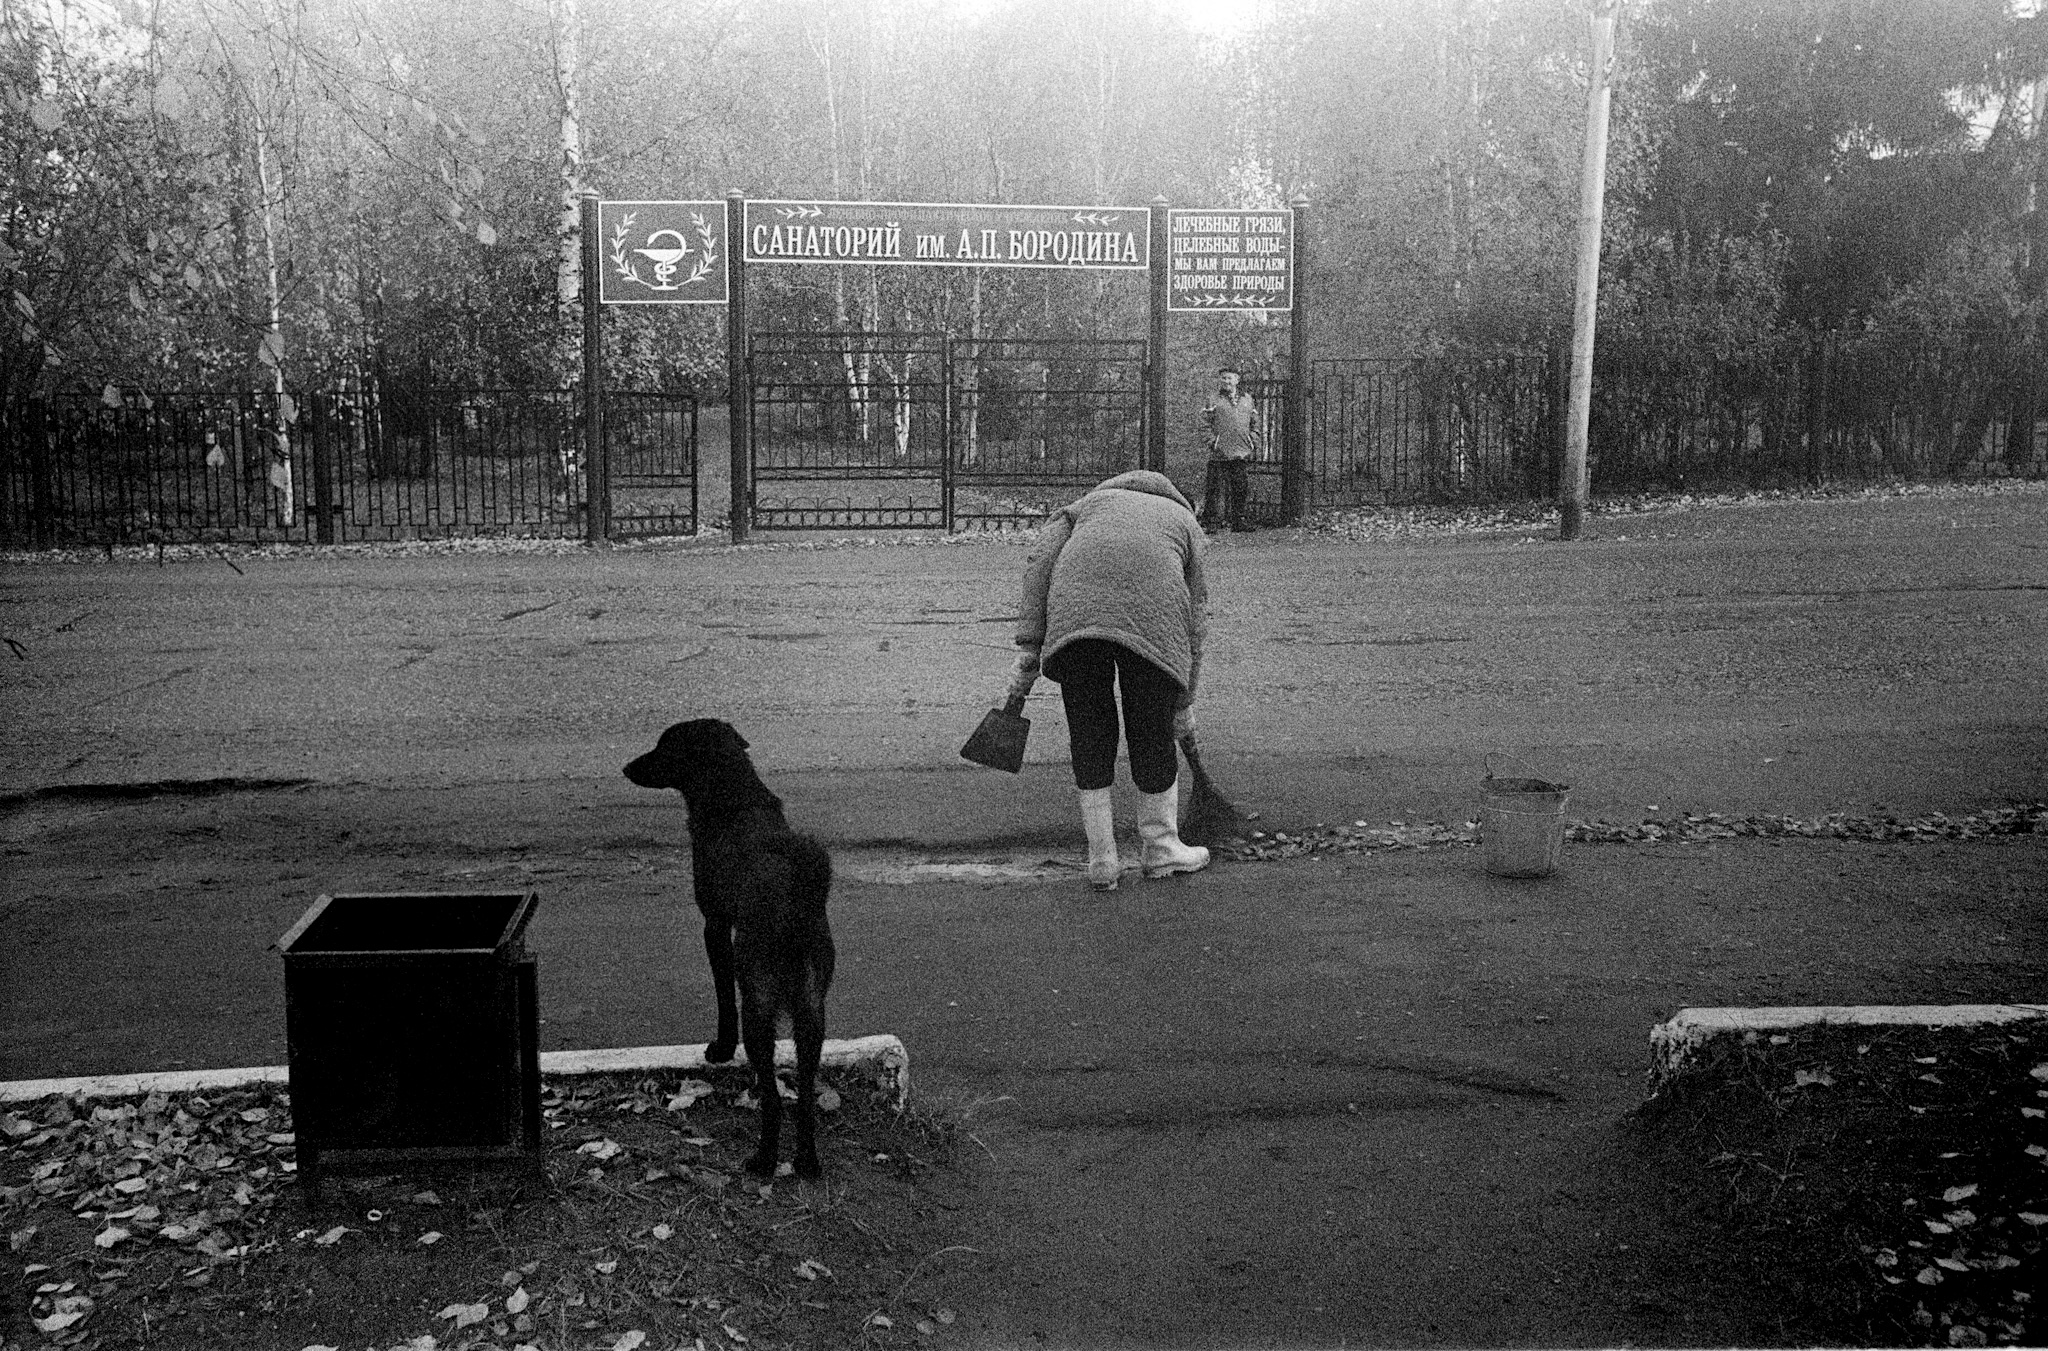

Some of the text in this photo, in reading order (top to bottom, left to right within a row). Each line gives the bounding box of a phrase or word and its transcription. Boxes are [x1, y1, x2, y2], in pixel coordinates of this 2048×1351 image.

[1173, 216, 1286, 235] ЛЕЧЕБНЫЕ ГРЯЗИ,
[752, 221, 901, 257] САНАТОРИЙ
[1008, 230, 1139, 265] БОРОДИНА
[1174, 237, 1240, 256] ЦЕЛЕБНЫЕ
[1174, 258, 1286, 273] МЫ ВАМ ПРЕДЛАГАЕМ
[1173, 275, 1285, 293] ЗДОРОВЬЕ ПРИРОДЫ
